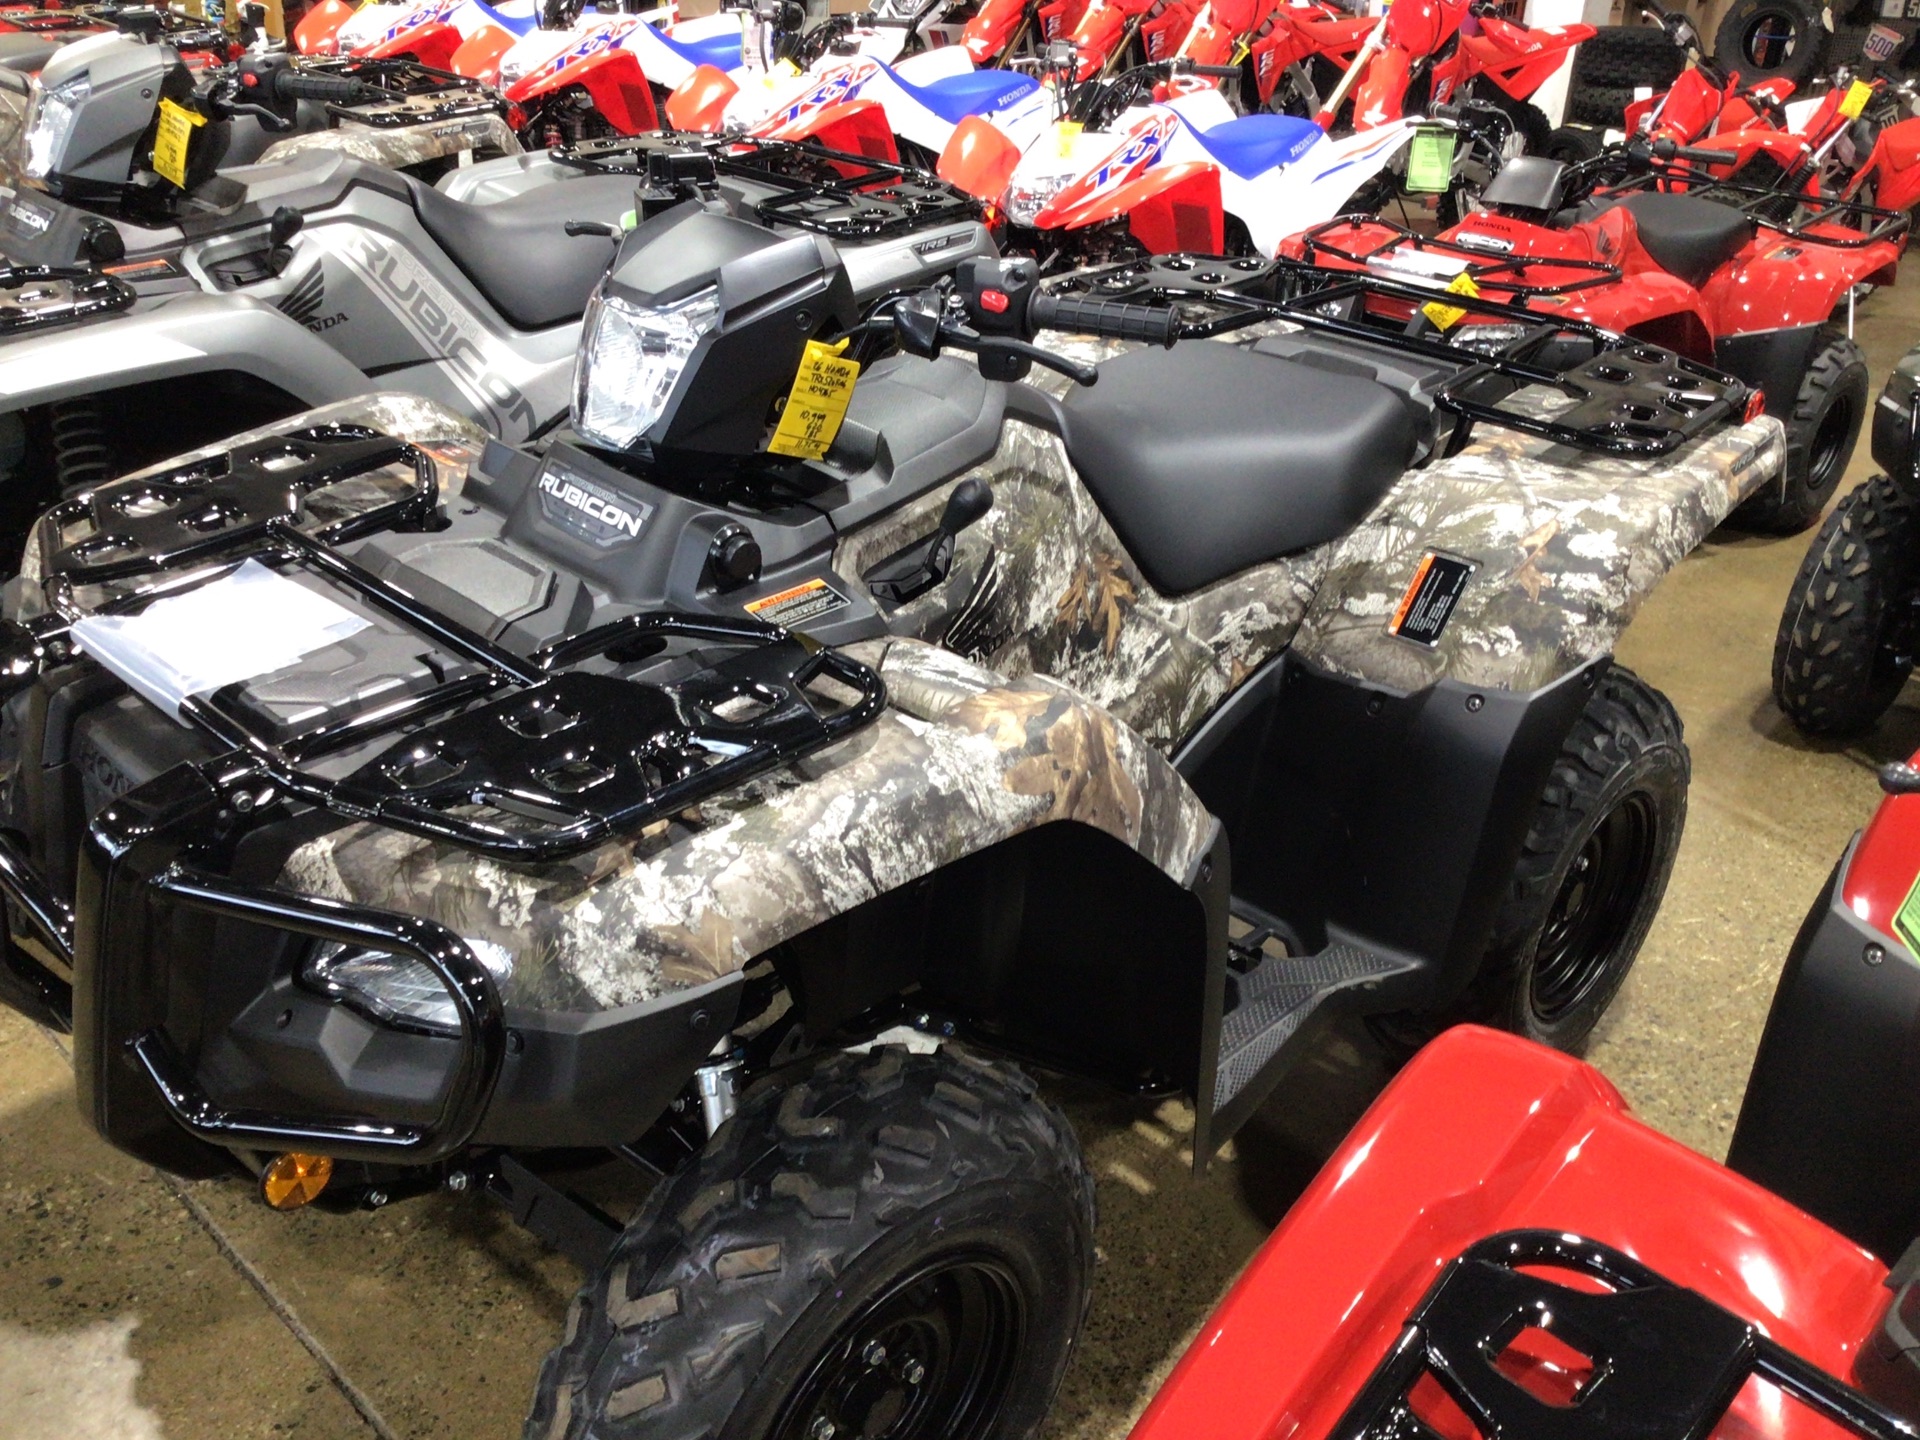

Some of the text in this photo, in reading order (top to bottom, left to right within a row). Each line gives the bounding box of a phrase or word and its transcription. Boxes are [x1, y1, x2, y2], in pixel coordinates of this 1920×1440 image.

[1865, 33, 1895, 57] 500
[779, 70, 850, 123] TRX
[998, 83, 1032, 106] HONDA
[437, 124, 462, 136] IRS
[1290, 130, 1319, 157] HONDA
[1087, 125, 1161, 188] TRX
[8, 203, 49, 231] UBICON
[1473, 220, 1511, 232] HONDA
[921, 237, 948, 251] IRS
[307, 313, 349, 333] NDA
[539, 471, 643, 537] RUBICON
